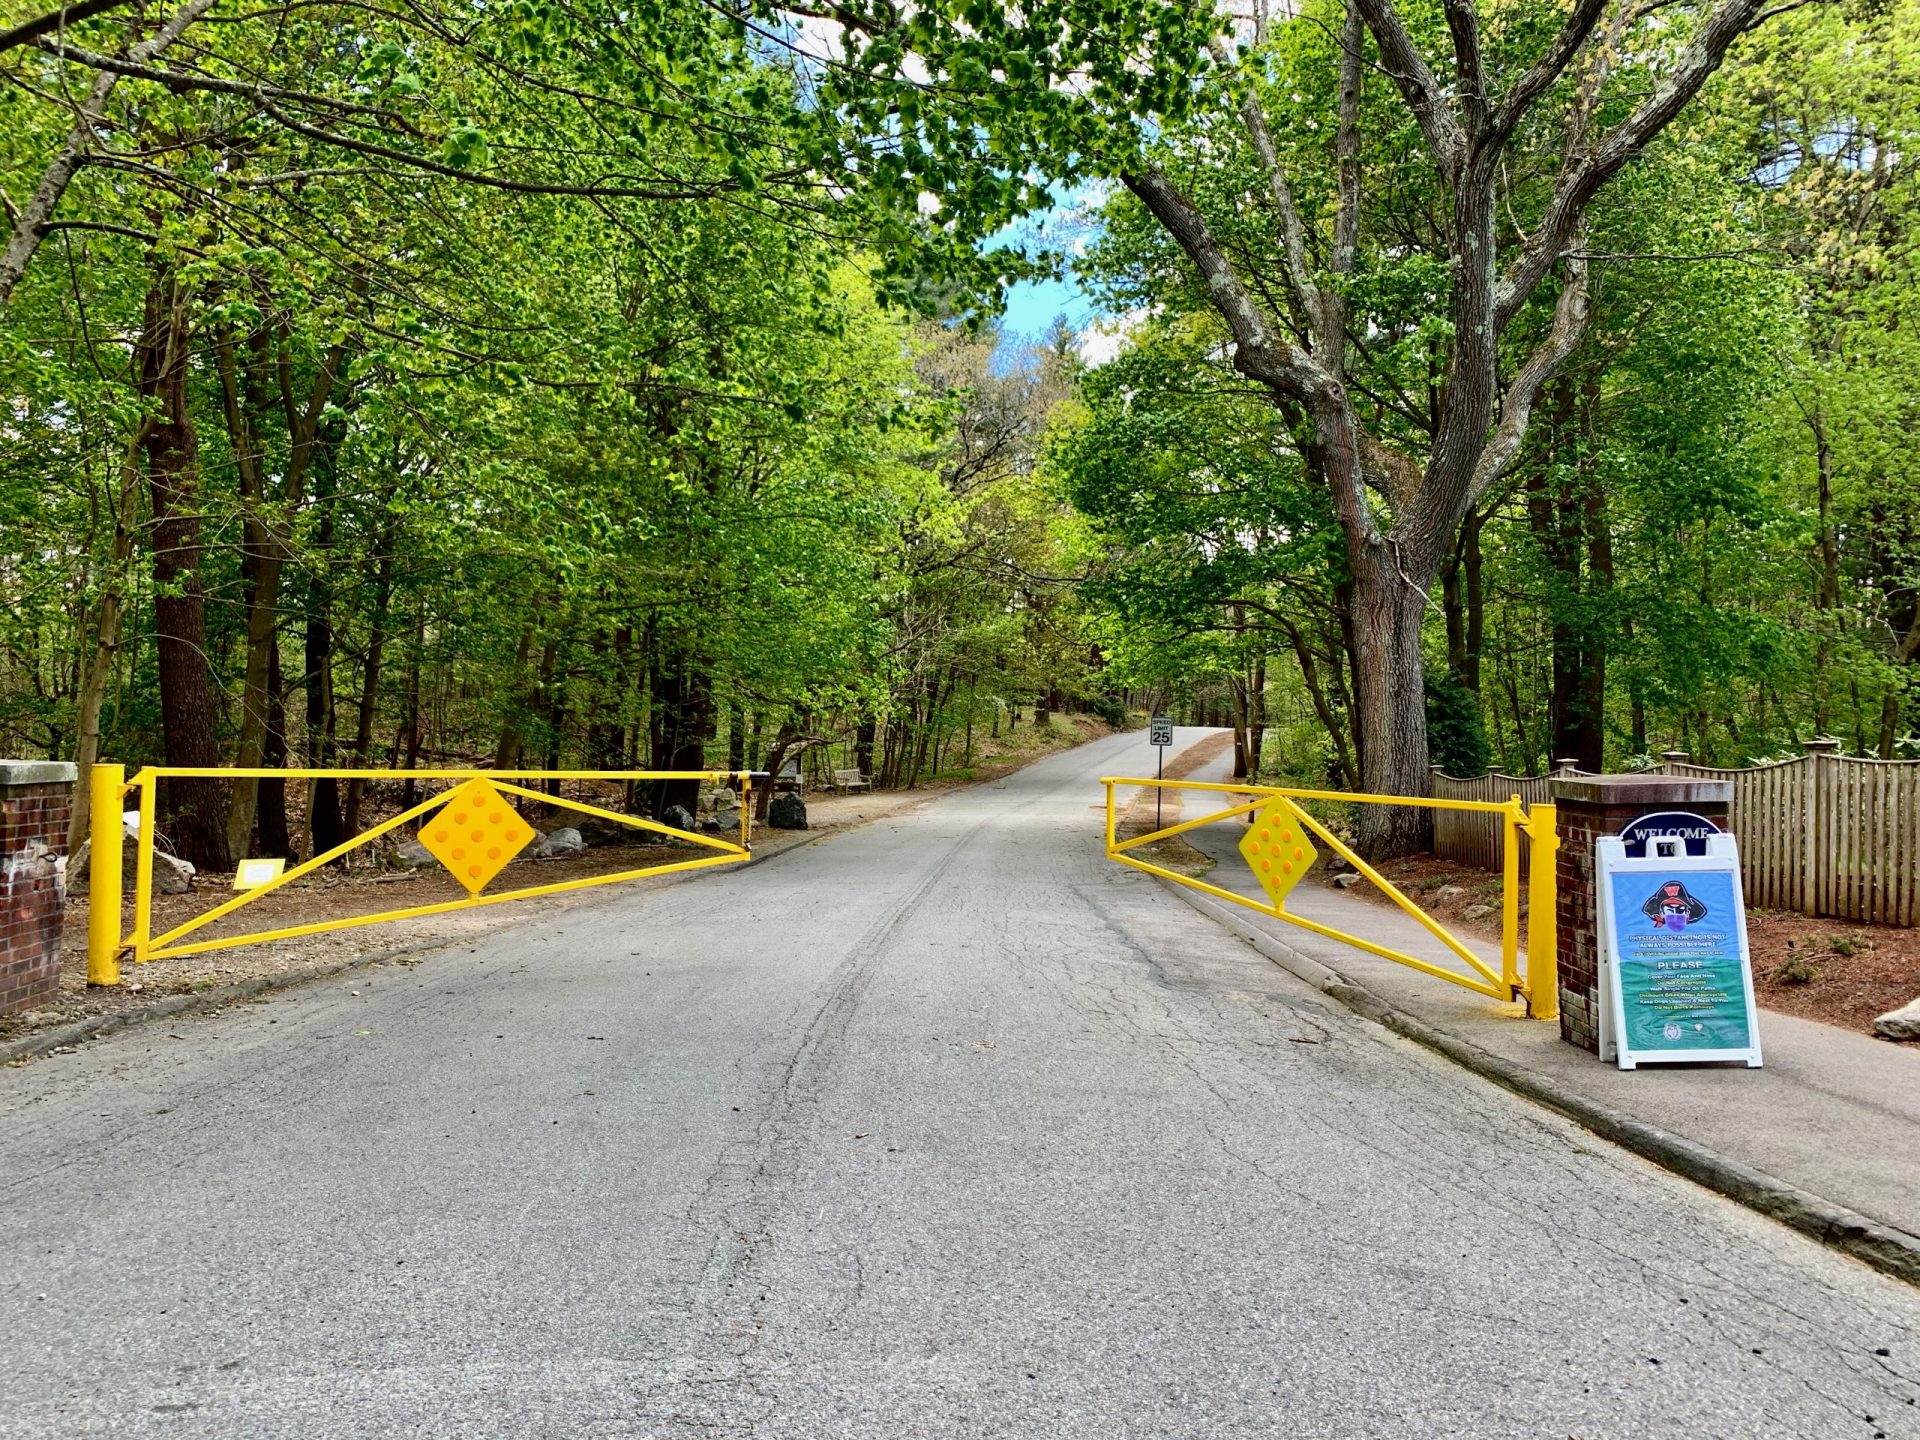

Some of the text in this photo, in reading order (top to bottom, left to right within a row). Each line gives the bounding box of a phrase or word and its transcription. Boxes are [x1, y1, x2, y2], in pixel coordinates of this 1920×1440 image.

[1153, 732, 1170, 743] 25
[1633, 828, 1709, 840] WELCOME
[1664, 886, 1680, 897] W
[1657, 961, 1703, 970] PLEASE
